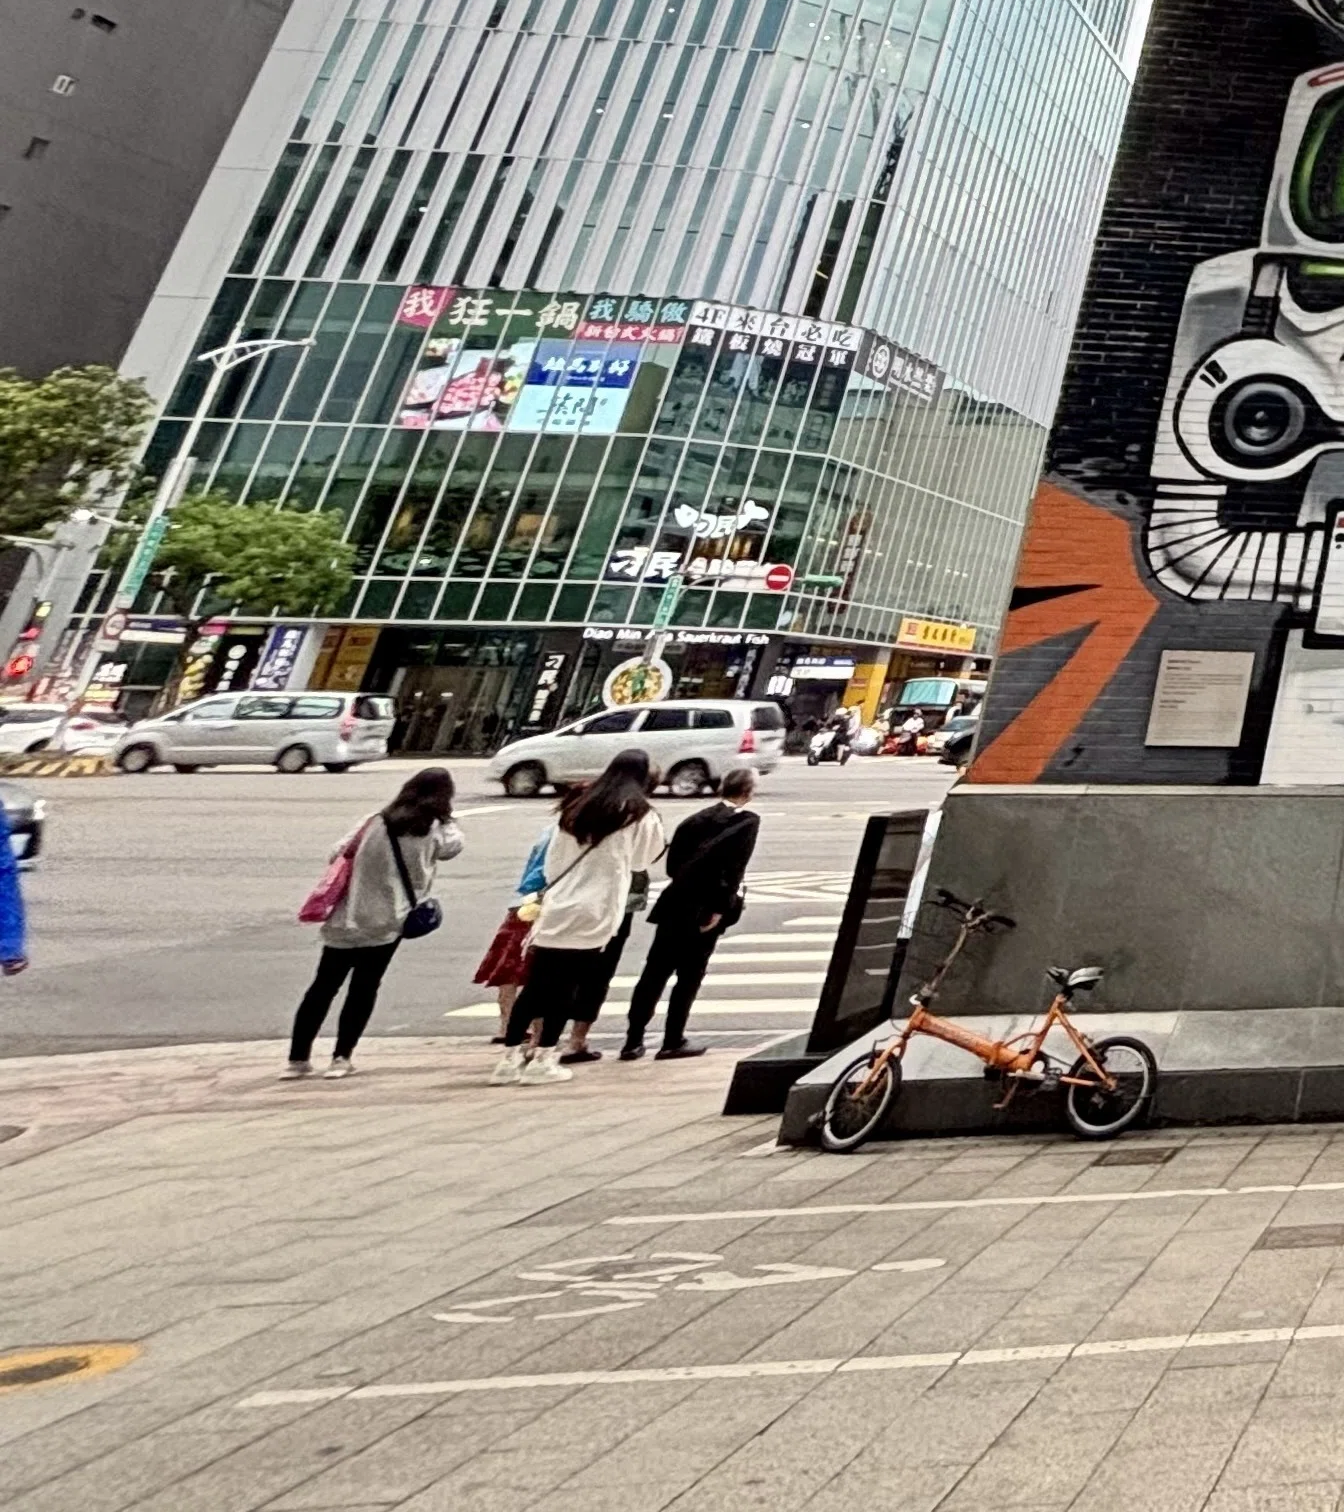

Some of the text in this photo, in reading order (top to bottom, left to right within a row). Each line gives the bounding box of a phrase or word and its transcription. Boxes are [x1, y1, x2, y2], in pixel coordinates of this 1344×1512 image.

[582, 627, 614, 640] Diao
[616, 627, 642, 641] Min
[676, 629, 743, 644] Sauerkraut
